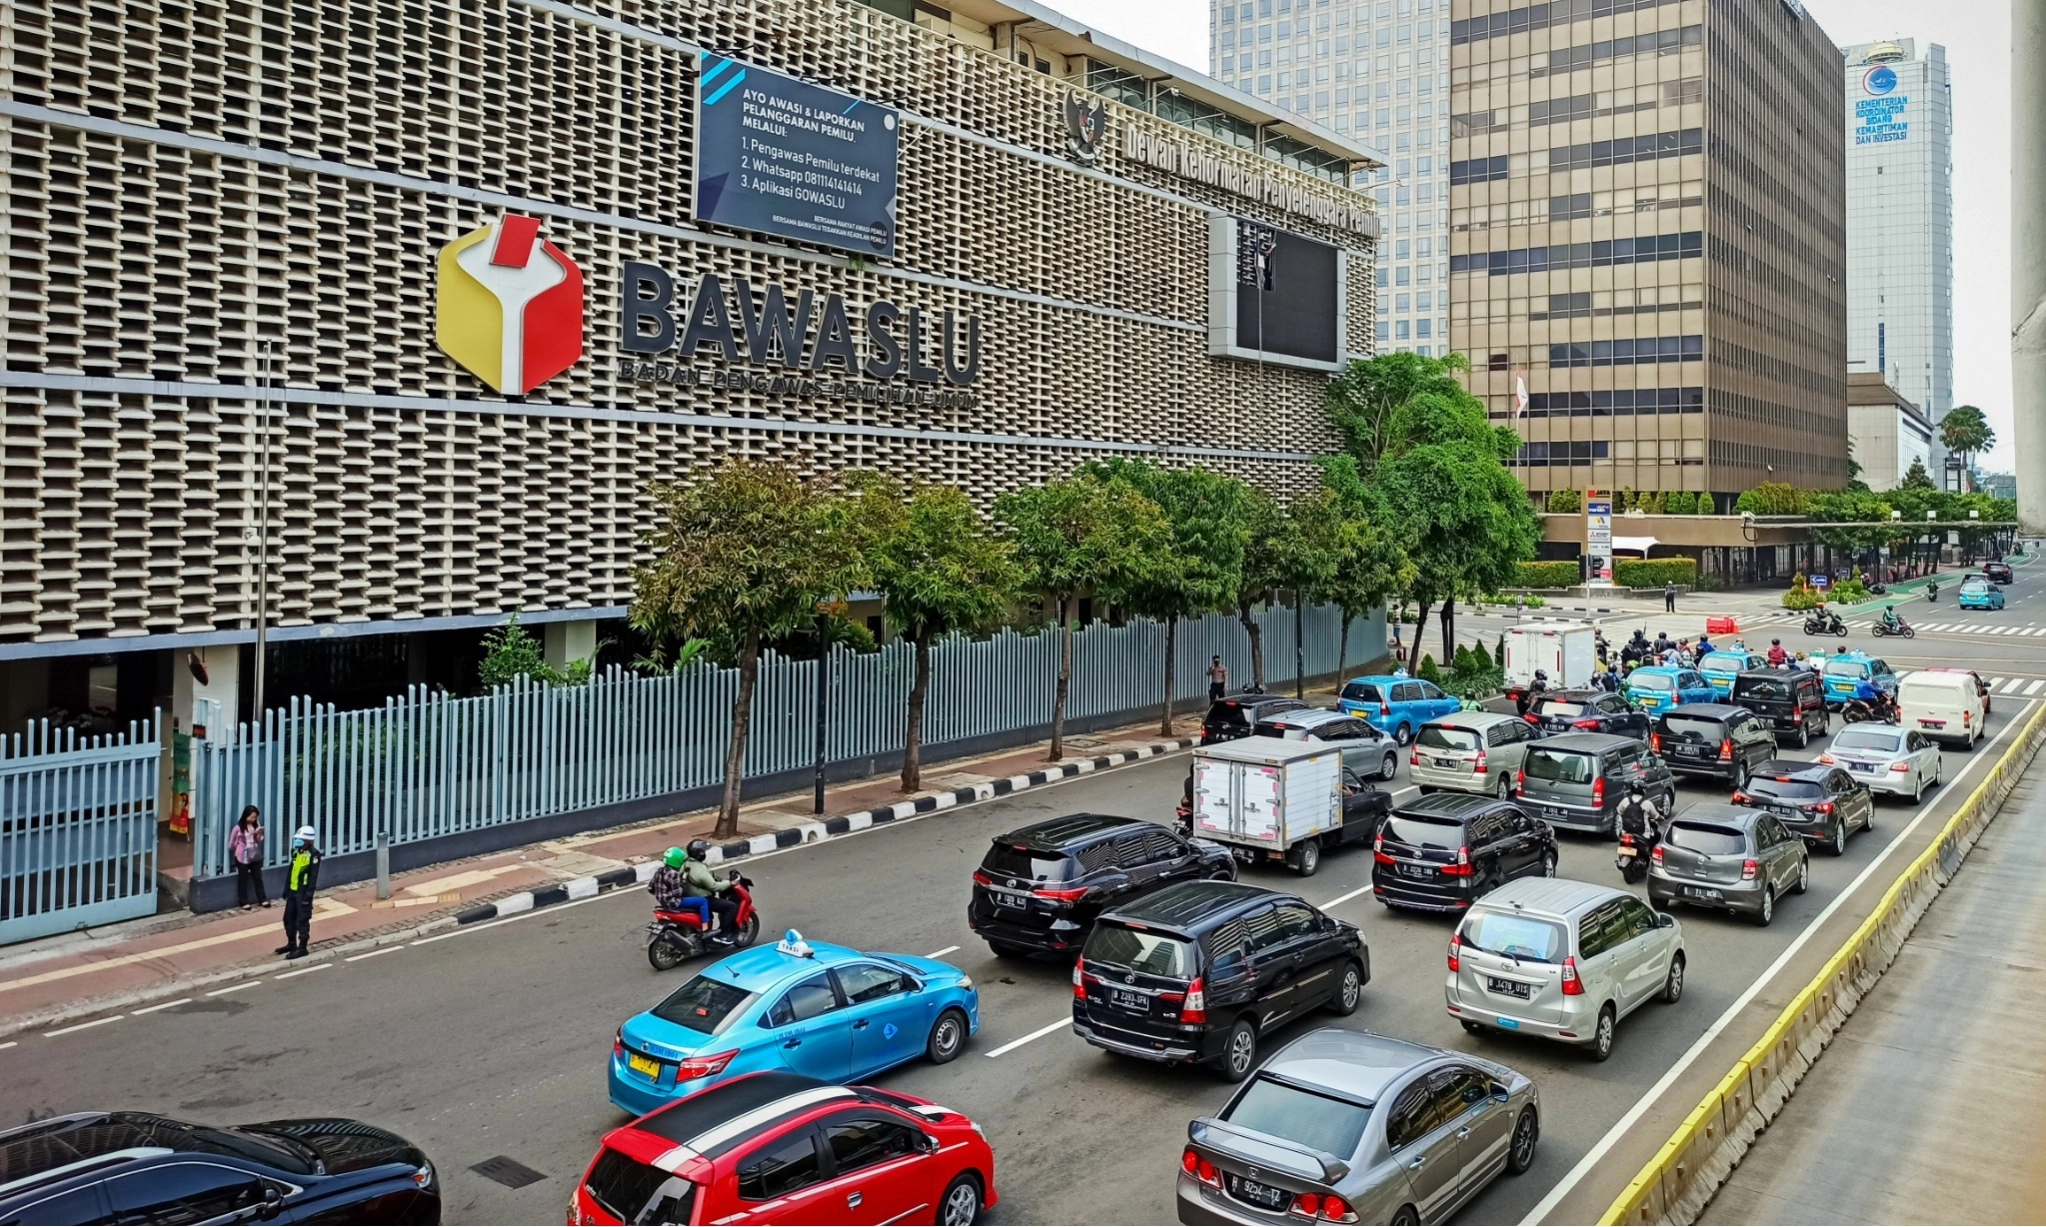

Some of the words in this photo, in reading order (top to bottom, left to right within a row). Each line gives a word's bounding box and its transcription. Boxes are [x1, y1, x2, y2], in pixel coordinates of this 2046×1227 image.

[743, 88, 767, 104] AYO
[769, 96, 802, 115] AWASI
[805, 107, 811, 117] &
[814, 108, 865, 132] LAPORKAN
[1856, 96, 1908, 110] KEMENTERIAN
[1856, 104, 1905, 118] KOORDINATOR
[1866, 114, 1893, 125] BIDANG
[742, 115, 788, 137] MELALUI:
[743, 102, 819, 133] PELANGGARAN
[821, 123, 857, 143] PEMILU.
[1856, 135, 1872, 145] DAN
[1873, 131, 1907, 143] INVESTASI
[741, 136, 749, 150] 1.
[751, 138, 804, 163] Pengawas
[805, 153, 840, 173] Pemilu
[841, 162, 880, 183] terdekat
[741, 155, 751, 169] 2.
[752, 158, 803, 184] Whatsapp
[804, 171, 862, 196] 081114141414
[1127, 122, 1177, 173] Dewan
[1180, 141, 1261, 201] Kehormatan
[1263, 173, 1347, 229] Penyelenggara
[740, 174, 750, 188] 3.
[751, 177, 794, 198] Aplikasi
[795, 187, 846, 210] GOWASLU
[772, 214, 797, 225] BERSAMA
[797, 220, 821, 232] BAWASLU
[821, 224, 847, 237] TEGAKKAN
[847, 231, 870, 241] KEADILAN
[870, 235, 887, 245] PEMILU
[814, 215, 838, 226] BERSAMA
[870, 227, 887, 237] PEMILU
[622, 260, 980, 385] BAWASLU
[620, 360, 701, 386] BADAN
[713, 369, 823, 397] PENGAWAS
[833, 381, 926, 405] PEMILIHAN
[1232, 1176, 1238, 1188] H
[1271, 1188, 1281, 1202] TZ
